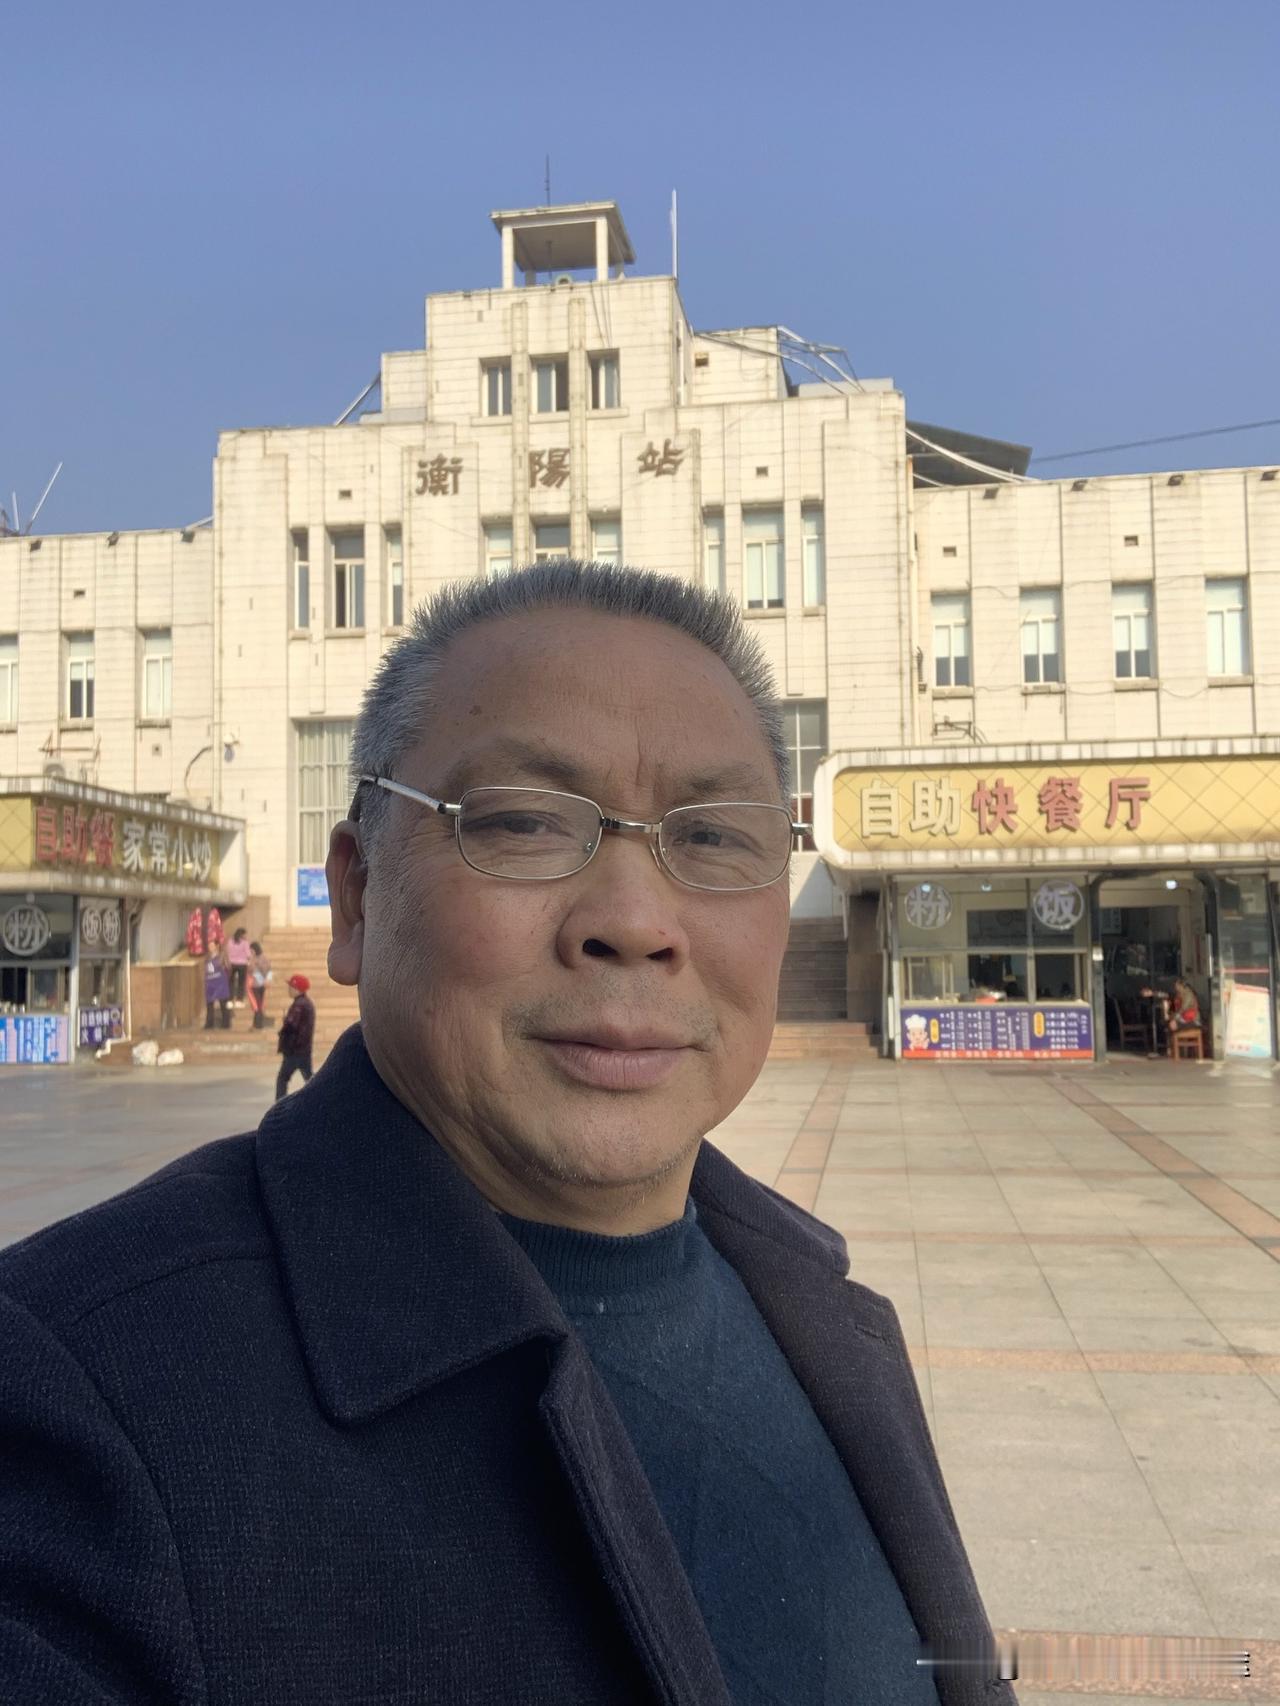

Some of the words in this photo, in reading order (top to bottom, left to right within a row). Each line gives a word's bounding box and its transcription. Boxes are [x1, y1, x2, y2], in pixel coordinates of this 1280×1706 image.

[415, 438, 684, 495] 衡陽站
[861, 775, 1151, 838] 自助快餐厅
[123, 817, 212, 882] 家常小炒
